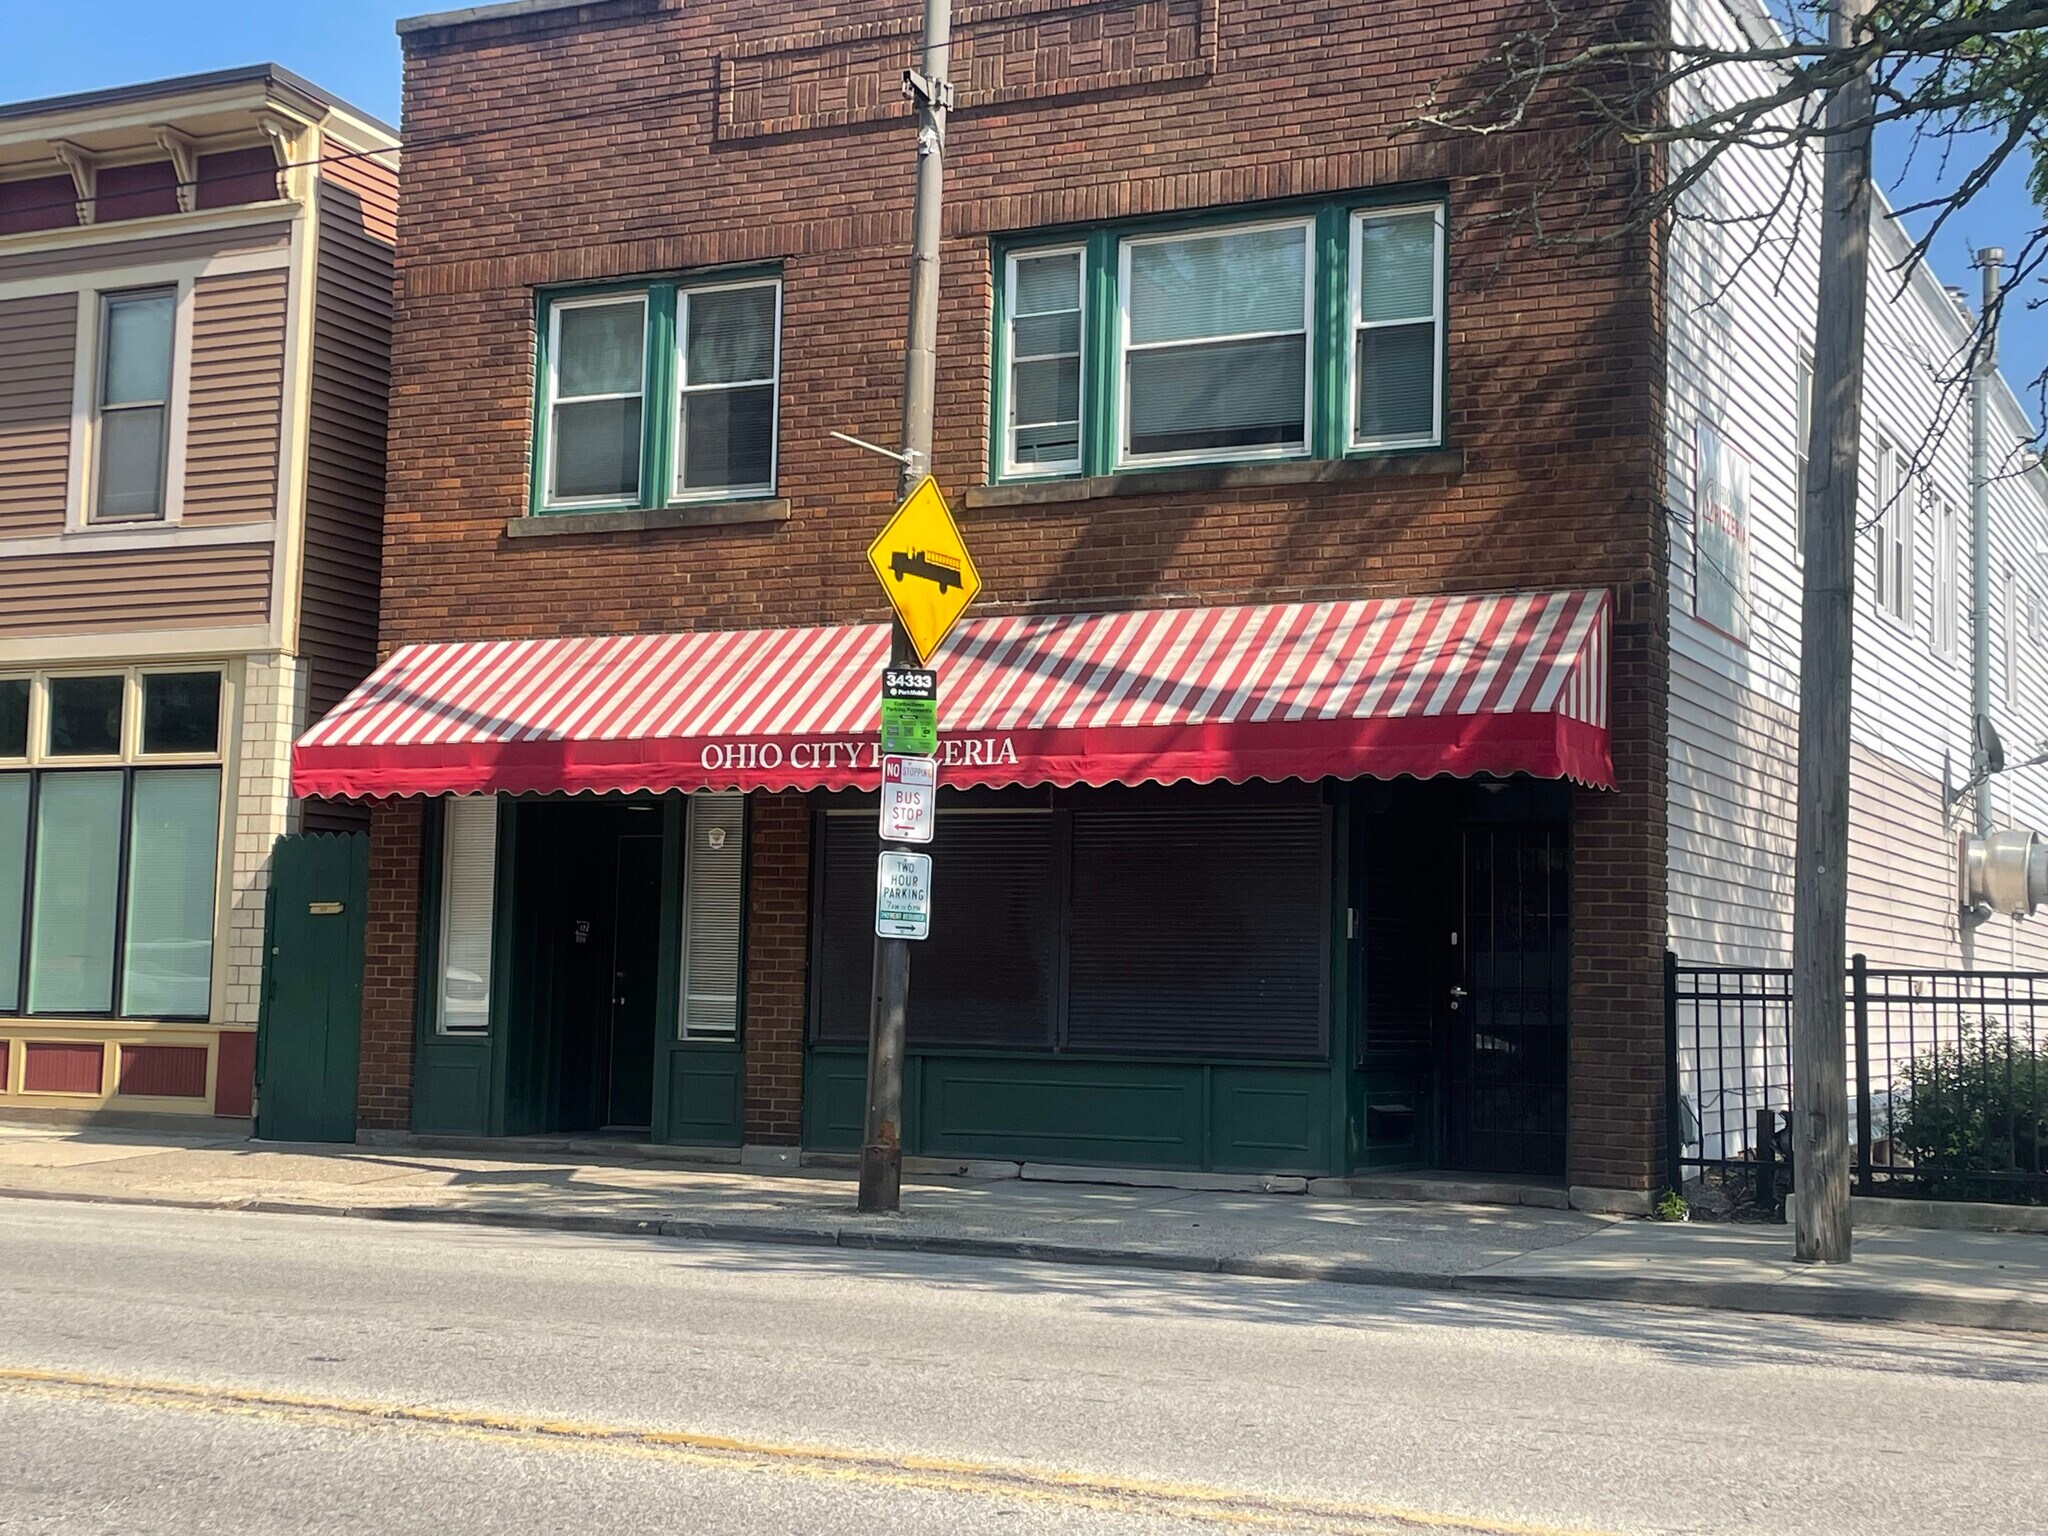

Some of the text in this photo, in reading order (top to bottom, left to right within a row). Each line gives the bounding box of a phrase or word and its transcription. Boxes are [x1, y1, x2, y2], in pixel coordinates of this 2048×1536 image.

[886, 674, 932, 688] 34333
[897, 689, 929, 697] ParkMobile
[701, 743, 783, 770] OHIO
[790, 742, 866, 769] CITY
[886, 763, 932, 778] NO STOPPING
[896, 791, 921, 805] BUS
[892, 807, 923, 821] STOP
[897, 861, 915, 873] TWO
[891, 874, 919, 887] HOUR
[883, 887, 925, 901] PARKING
